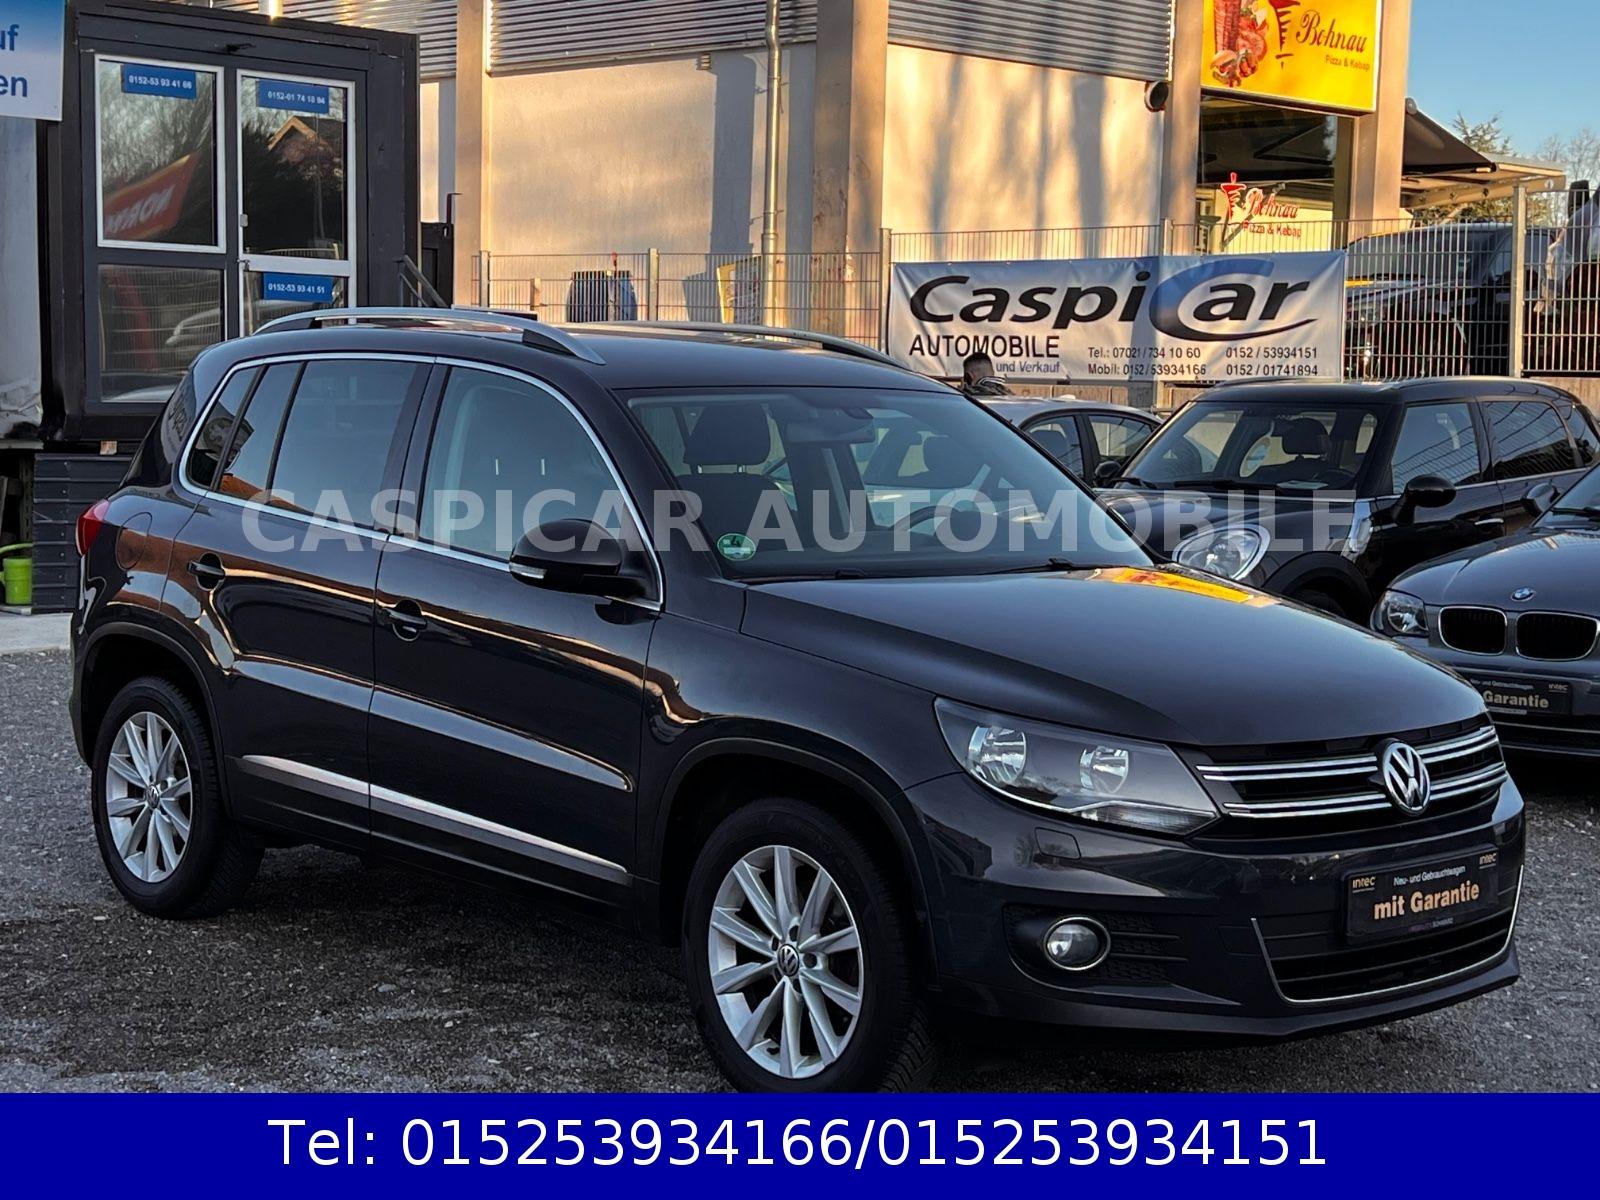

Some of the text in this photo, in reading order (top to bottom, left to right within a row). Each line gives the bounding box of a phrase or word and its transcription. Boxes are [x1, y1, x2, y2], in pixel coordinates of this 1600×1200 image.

[1296, 9, 1367, 53] Bohnau
[1325, 55, 1342, 66] Pizza
[1350, 59, 1370, 71] Kebap
[128, 75, 159, 86] 0152-53
[171, 80, 181, 88] 41
[297, 93, 305, 103] 74
[1243, 221, 1265, 234] Pizza
[1266, 223, 1274, 235] &
[267, 283, 325, 294] 0152-53 93 41 51
[909, 258, 1317, 343] CaspiCar
[909, 335, 1060, 358] AUTOMOBILE
[1225, 347, 1253, 359] 0152
[1263, 347, 1318, 359] 53934151
[1088, 347, 1109, 359] Tel.:
[1112, 347, 1141, 360] 07021
[1149, 347, 1165, 360] 734
[1169, 347, 1182, 359] 10
[1186, 347, 1201, 359] 60
[996, 360, 1060, 373] und Verkauf
[1088, 363, 1120, 375] Mobil:
[1123, 363, 1144, 376] 0152
[1150, 363, 1206, 375] 53934166
[1226, 364, 1253, 376] 0152
[1263, 364, 1318, 376] 01741894
[1483, 690, 1549, 708] Garantie
[1374, 880, 1480, 919] mit Garantie
